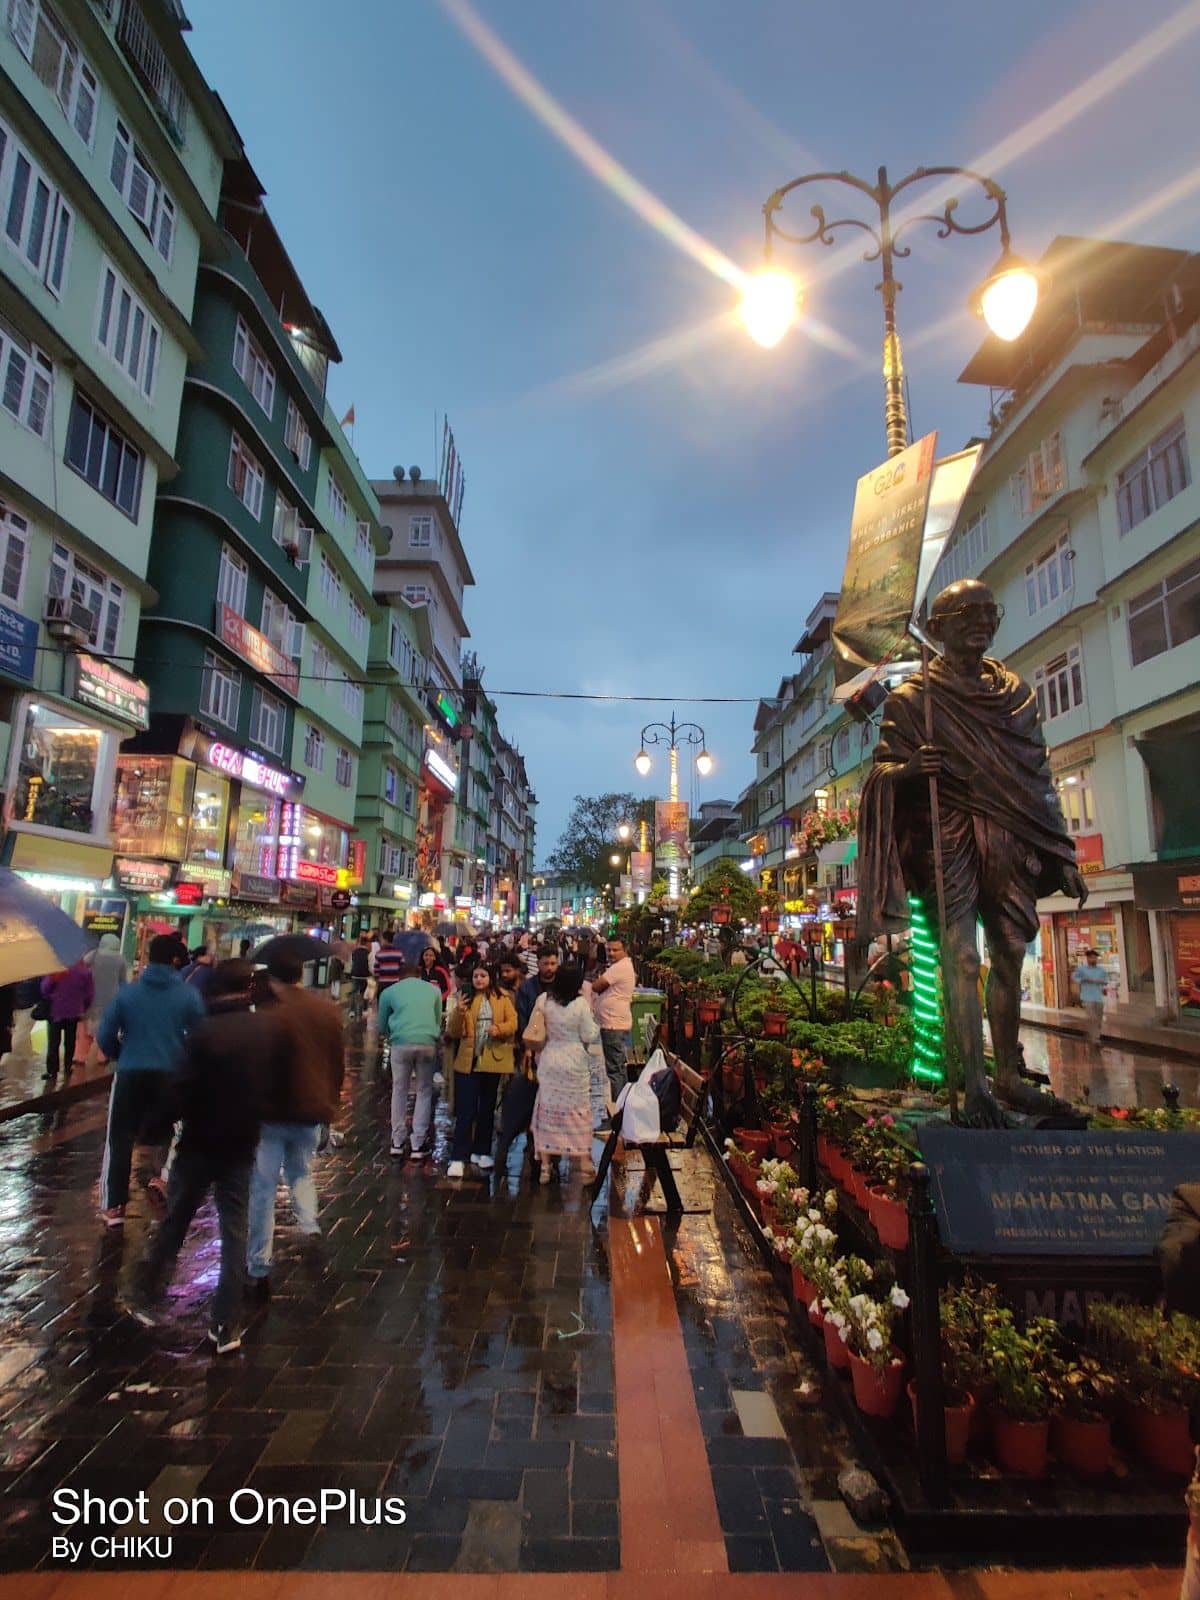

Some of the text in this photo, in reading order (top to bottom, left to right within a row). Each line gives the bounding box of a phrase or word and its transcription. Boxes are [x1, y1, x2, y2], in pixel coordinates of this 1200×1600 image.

[873, 518, 916, 545] ORGANIC
[1011, 1144, 1164, 1156] FATHER OF THE NATION
[990, 1190, 1117, 1210] MAHATMA
